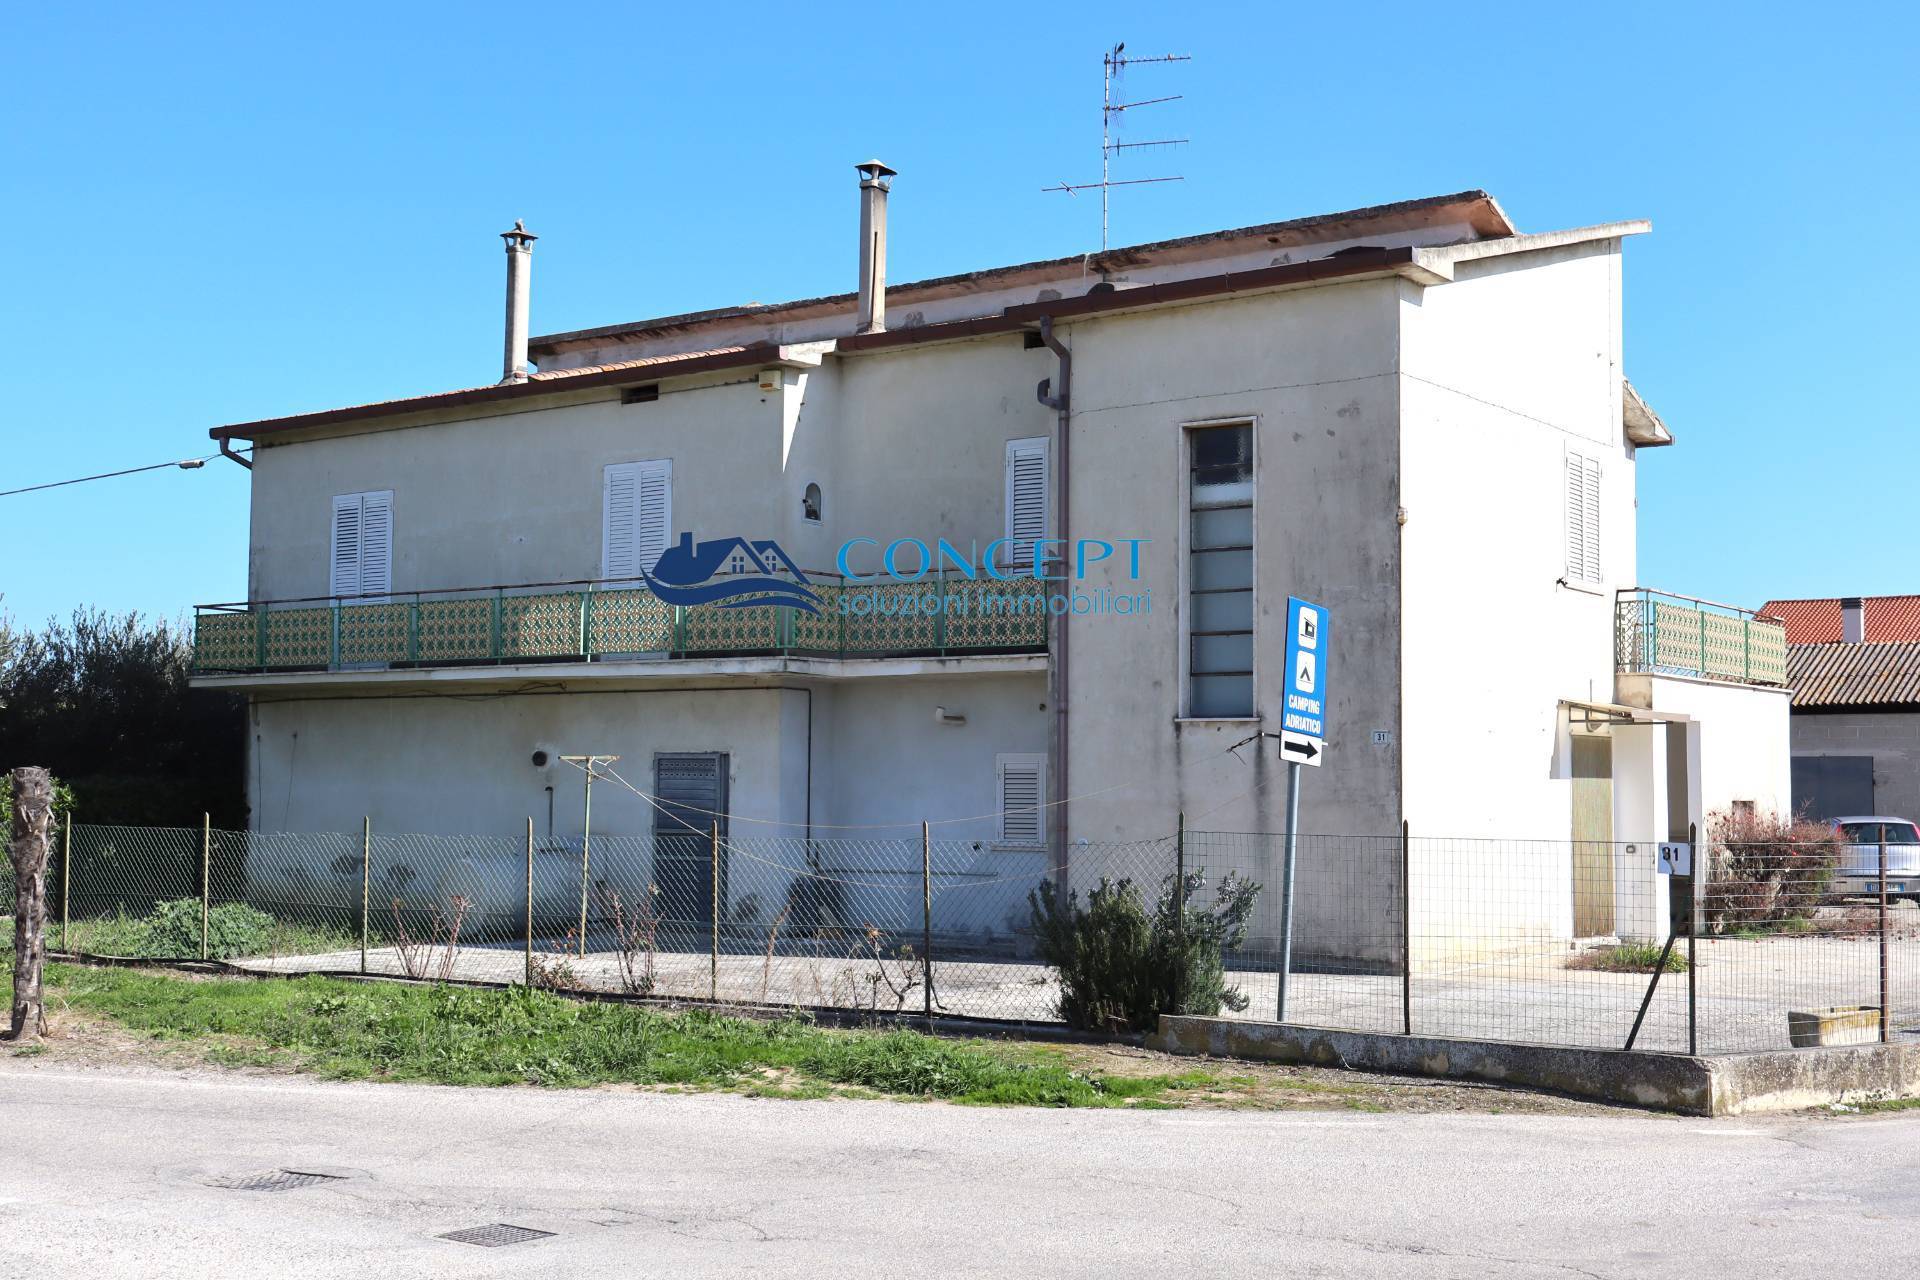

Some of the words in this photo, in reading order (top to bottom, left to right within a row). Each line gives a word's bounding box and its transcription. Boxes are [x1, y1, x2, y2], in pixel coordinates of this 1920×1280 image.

[1288, 694, 1320, 715] CAMPING
[1285, 713, 1321, 735] ADRIATICO
[1377, 733, 1386, 741] 31
